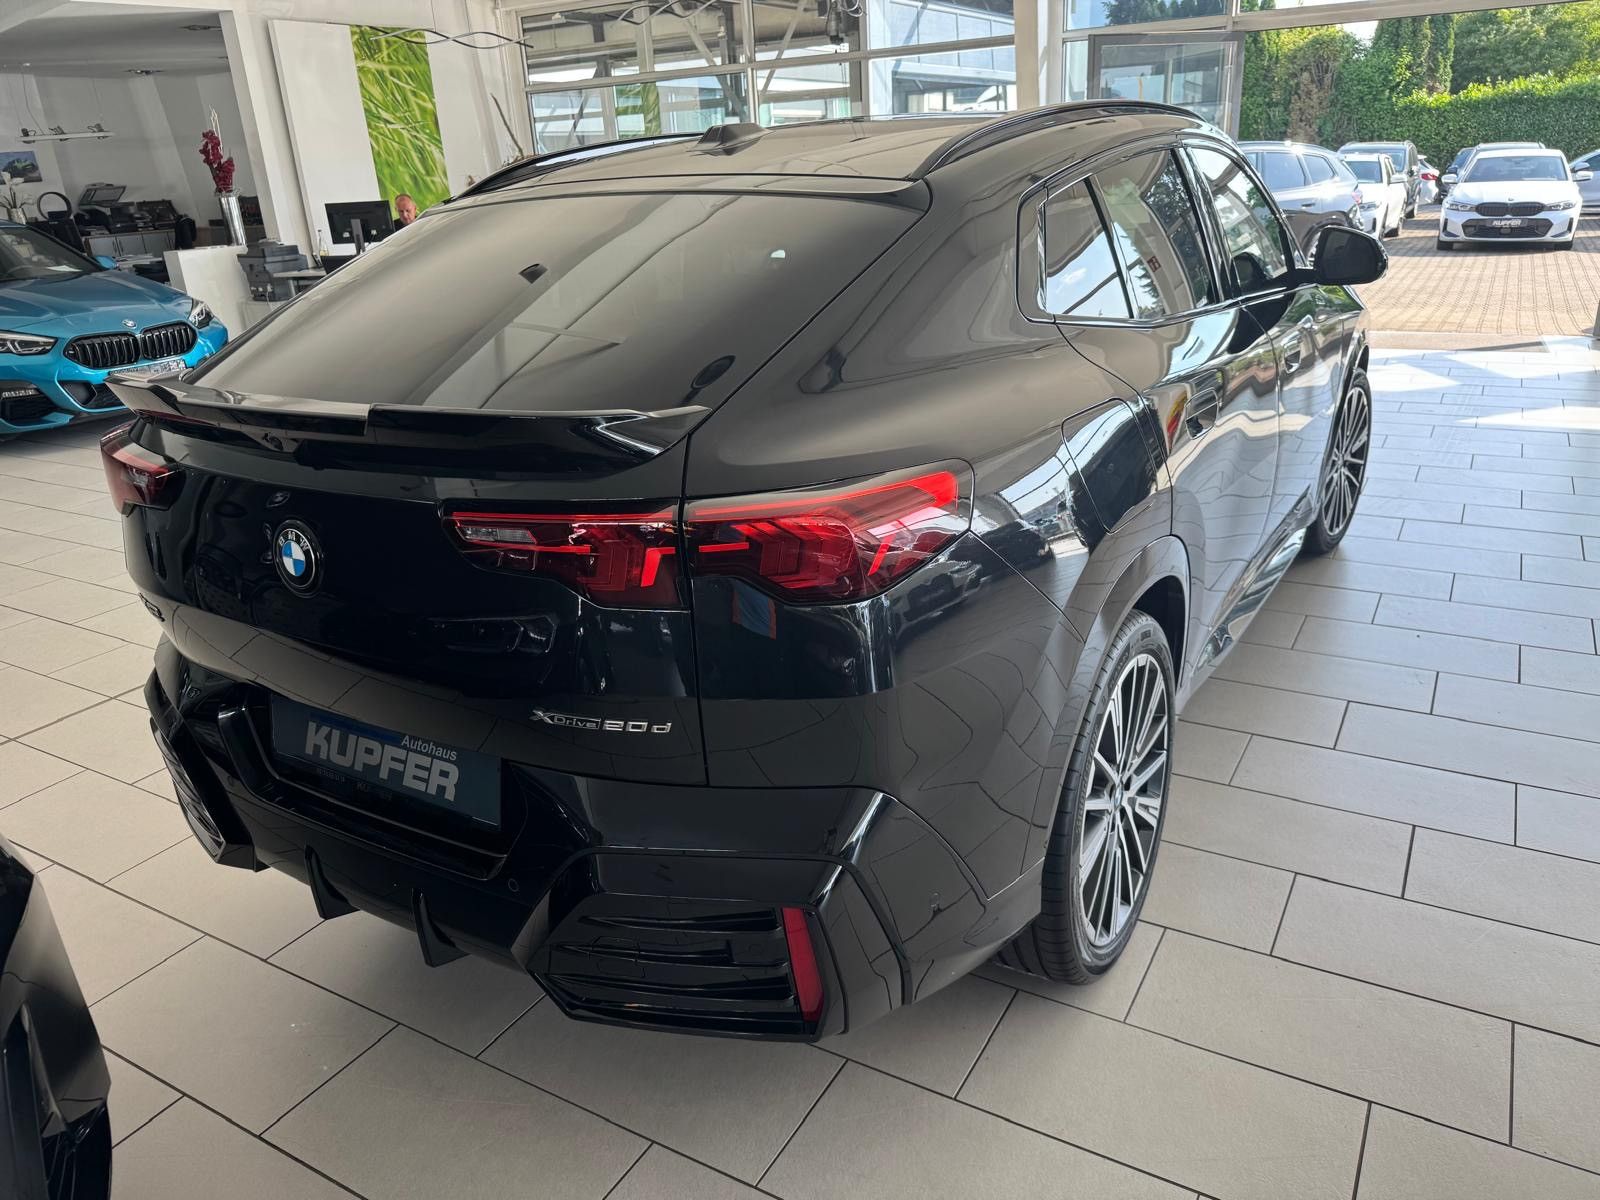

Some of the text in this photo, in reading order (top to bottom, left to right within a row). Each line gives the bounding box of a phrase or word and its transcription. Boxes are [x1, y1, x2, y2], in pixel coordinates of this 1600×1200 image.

[278, 530, 310, 551] BMW
[305, 720, 460, 802] KUPFER
[400, 734, 458, 761] Autohaus
